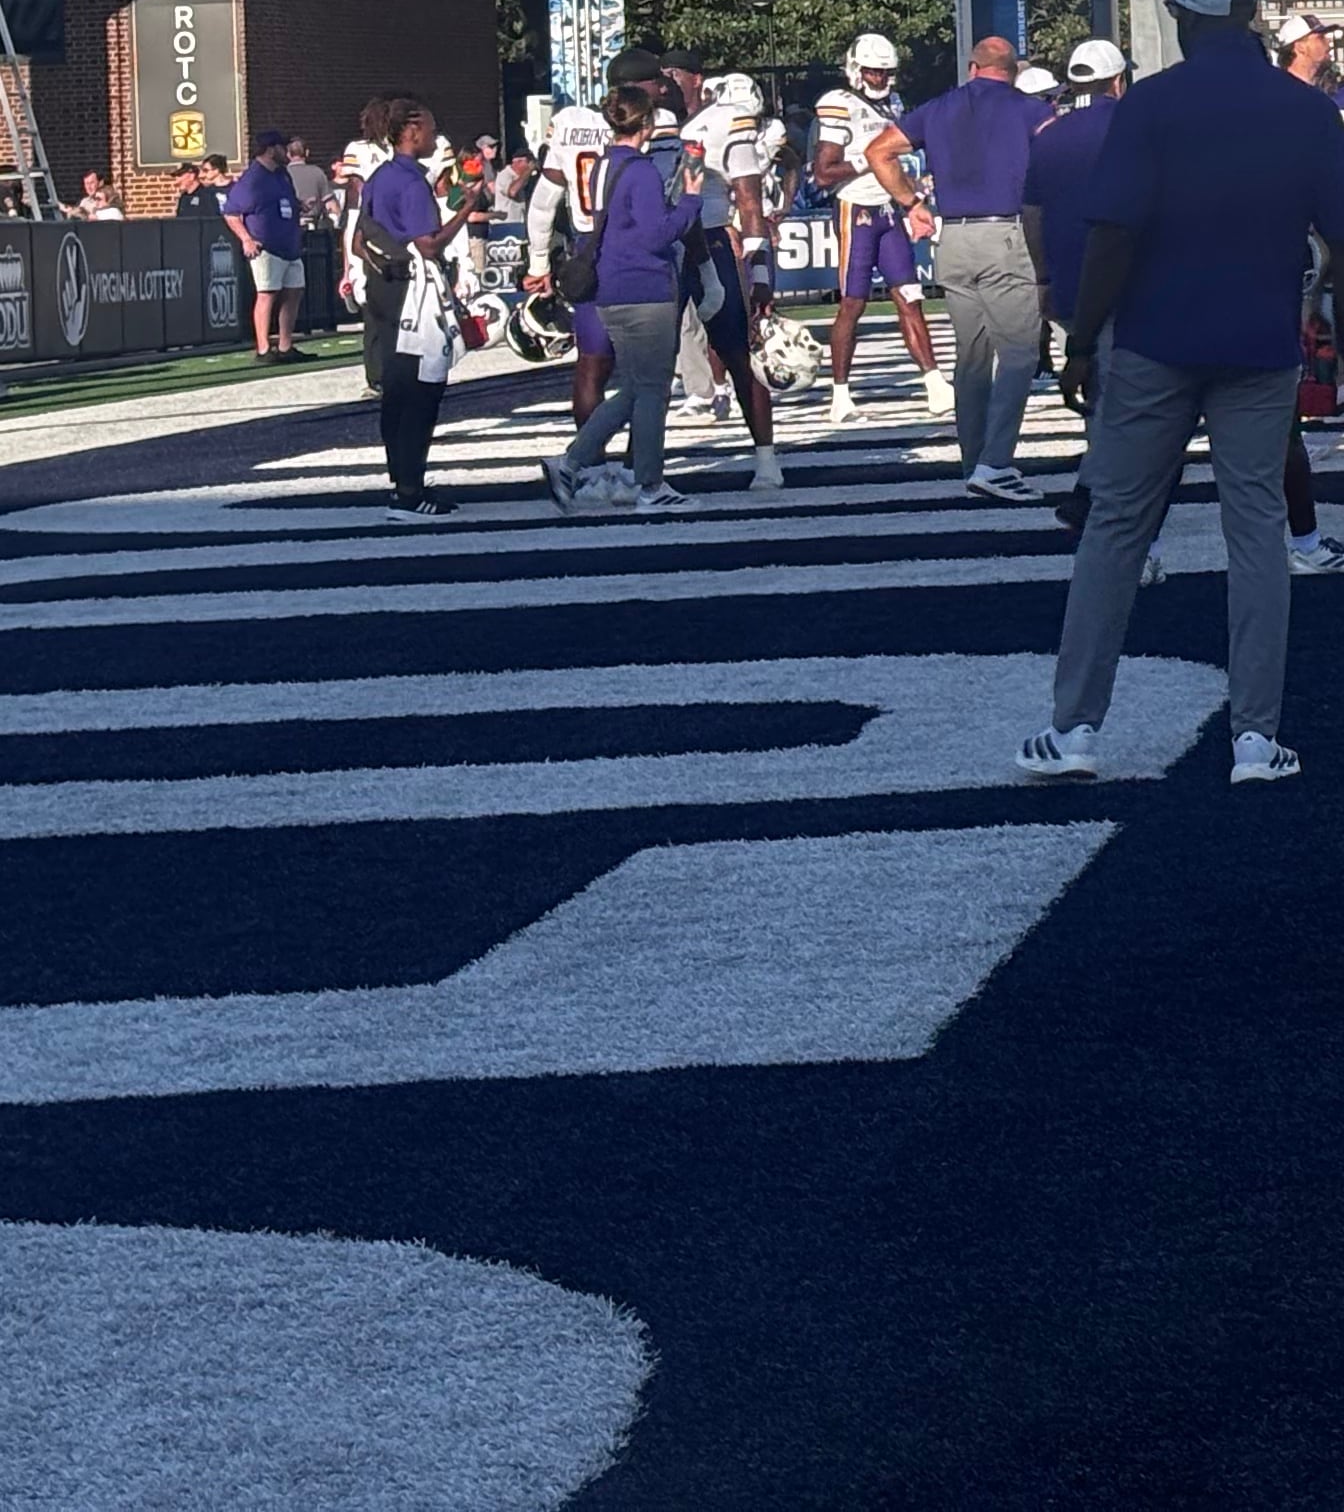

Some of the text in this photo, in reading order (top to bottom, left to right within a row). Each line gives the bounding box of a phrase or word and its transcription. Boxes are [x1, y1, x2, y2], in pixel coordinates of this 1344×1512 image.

[173, 5, 198, 106] ROTC
[90, 268, 184, 304] VIRGINIA LOTTERY
